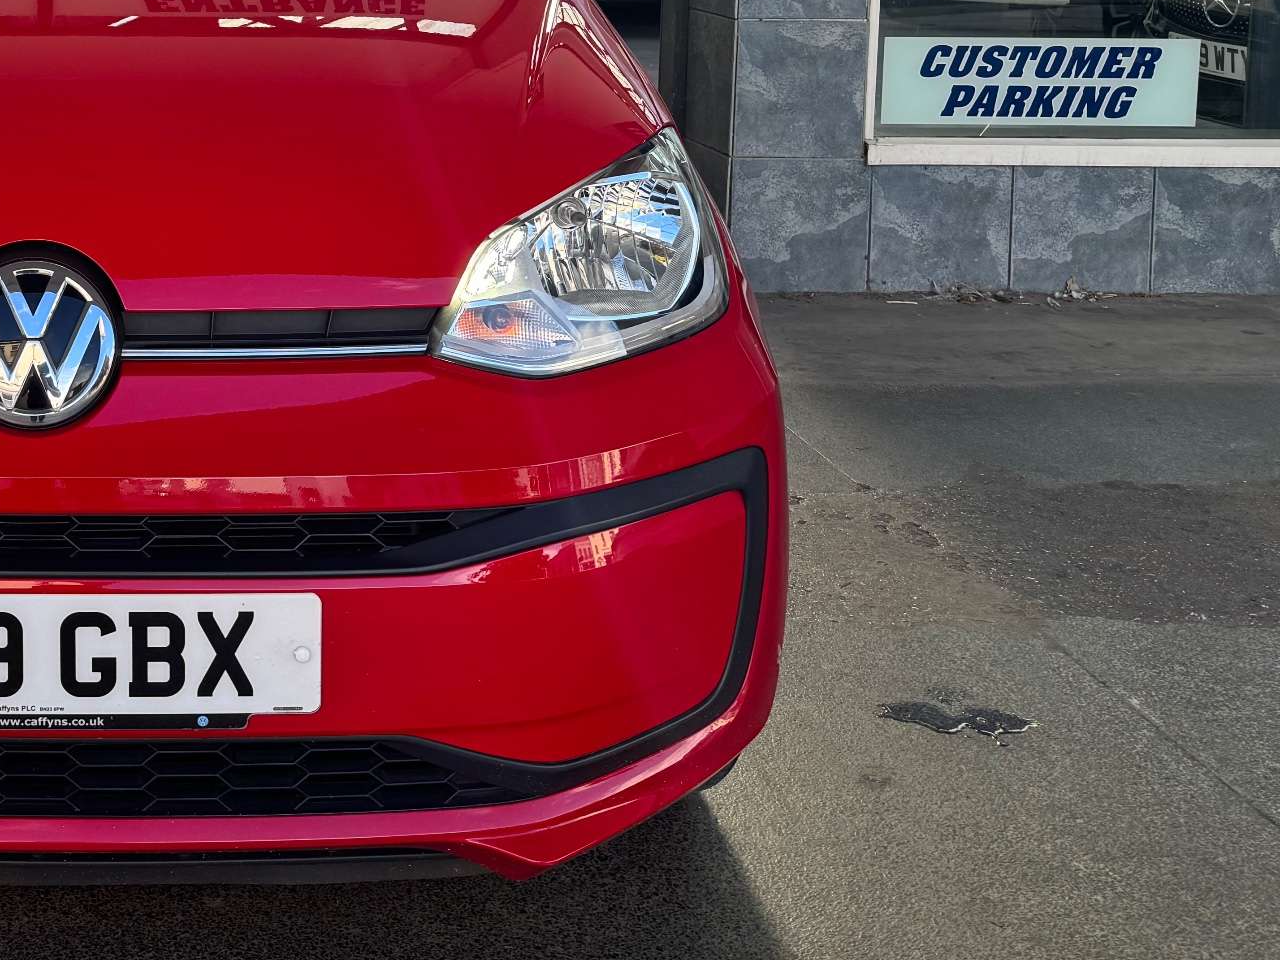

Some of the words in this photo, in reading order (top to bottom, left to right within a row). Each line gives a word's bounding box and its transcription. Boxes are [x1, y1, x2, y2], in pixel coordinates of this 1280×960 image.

[920, 44, 1163, 79] CUSTOMER
[940, 84, 1137, 119] PARKING
[59, 611, 255, 697] GBX
